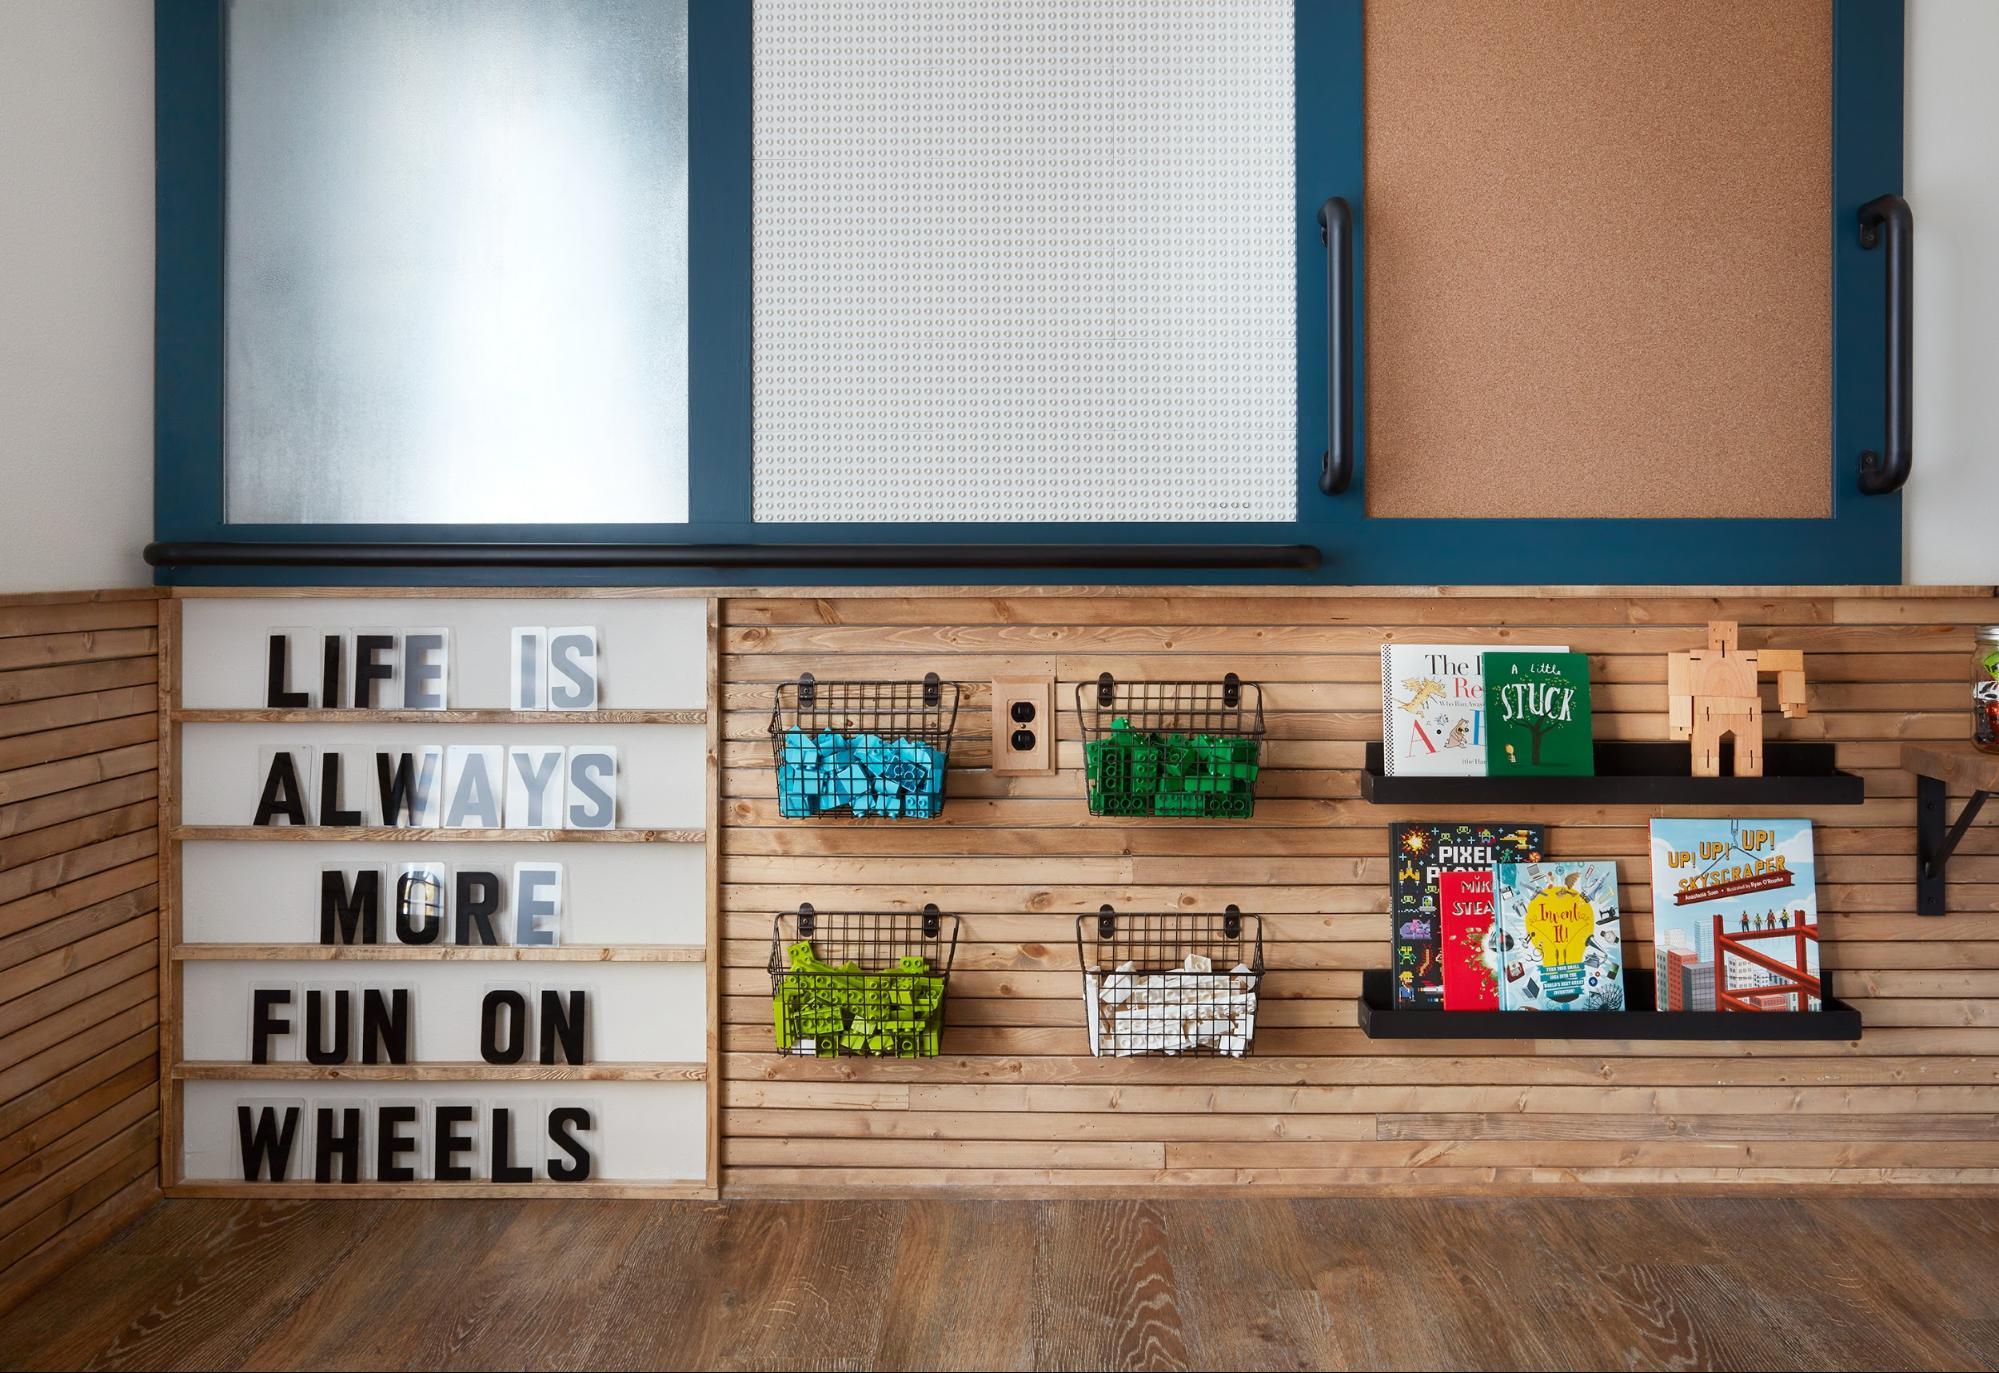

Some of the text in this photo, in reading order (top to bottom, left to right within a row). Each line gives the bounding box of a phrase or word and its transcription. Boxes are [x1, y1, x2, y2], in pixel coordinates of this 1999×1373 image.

[266, 634, 595, 709] LIFE IS
[1425, 654, 1469, 676] The
[1511, 663, 1561, 675] A Little
[1501, 682, 1575, 722] STUCK
[252, 751, 614, 828] ALWAYS
[1439, 846, 1497, 864] PIXEL
[1668, 829, 1775, 869] UP! UP! UP!
[1461, 878, 1493, 894] MIK
[1678, 855, 1786, 893] SKYSCRAPER
[320, 870, 557, 946] MORE
[1539, 902, 1578, 923] Invent
[1553, 924, 1569, 943] It!
[251, 988, 585, 1065] FUN ON
[237, 1106, 591, 1183] WHEELS
